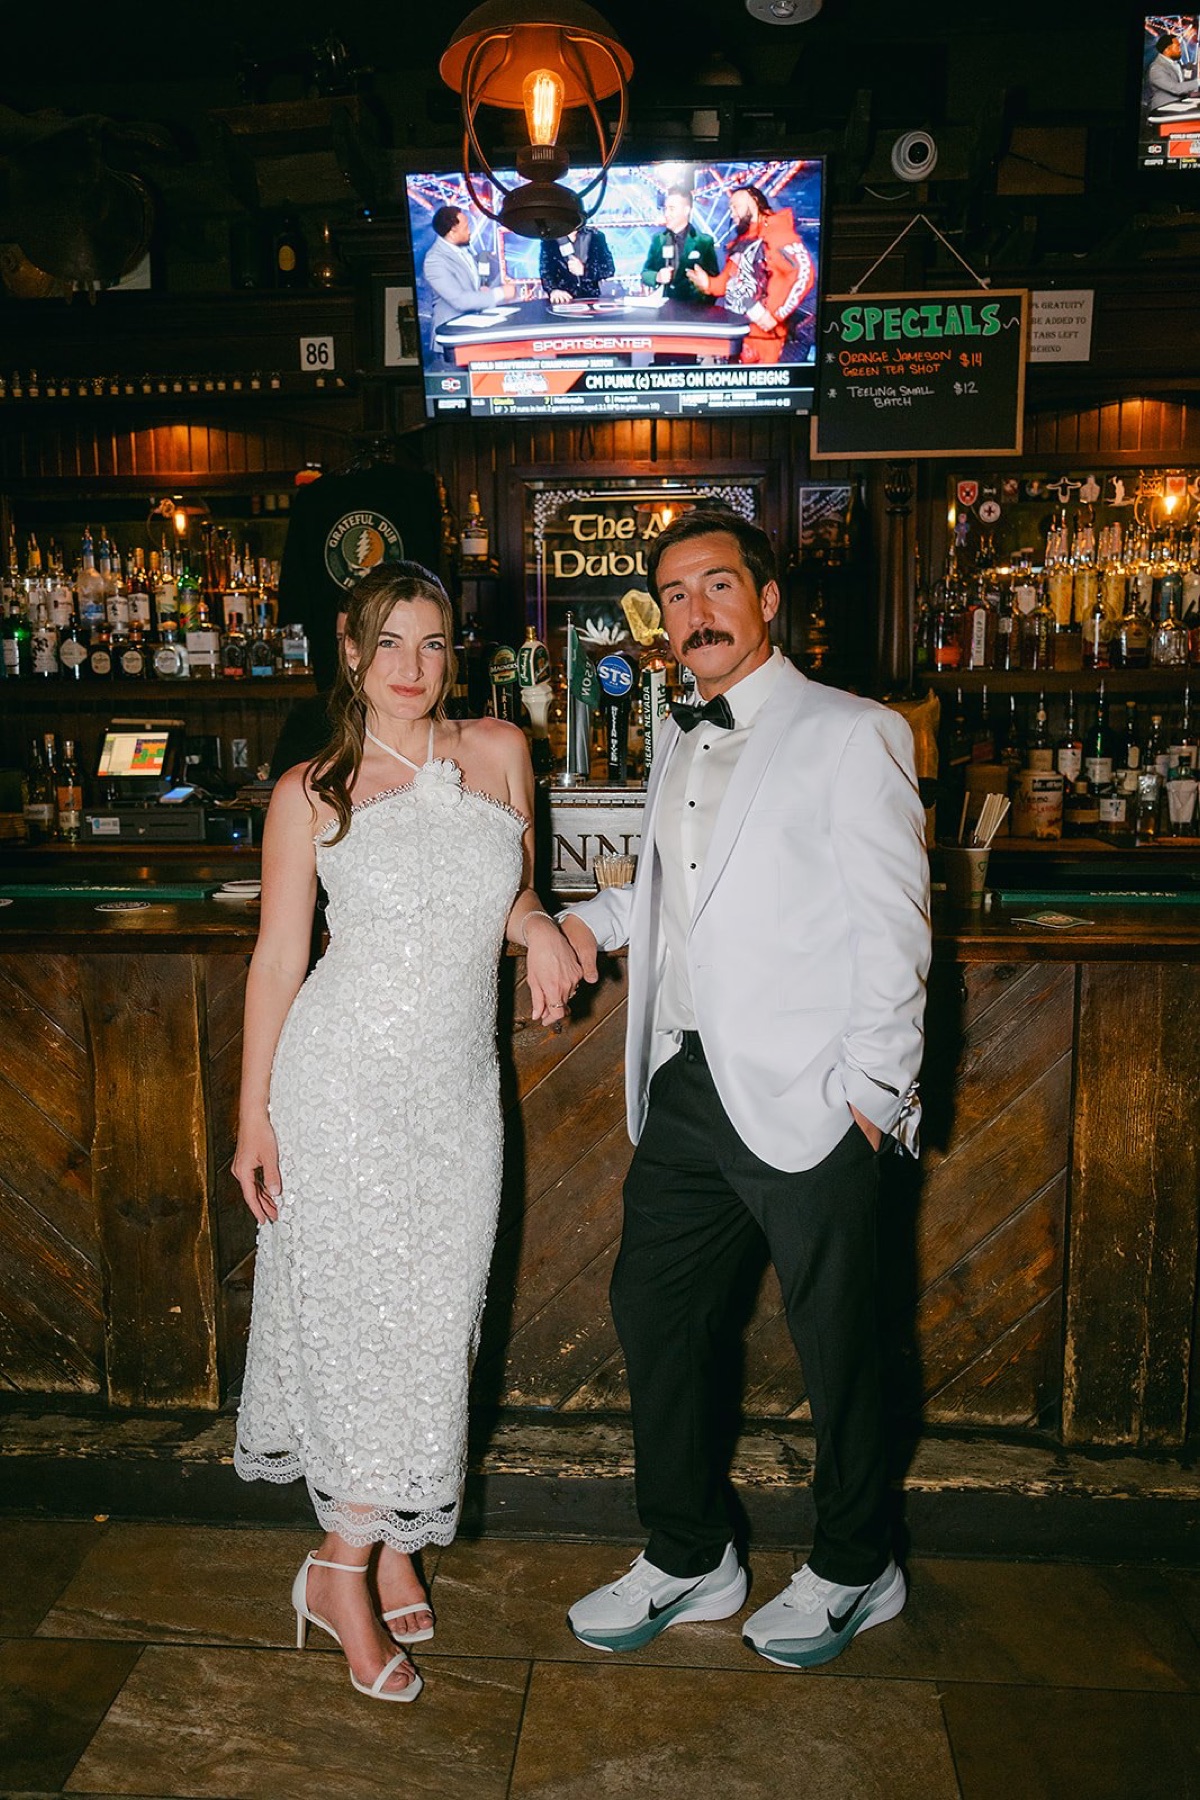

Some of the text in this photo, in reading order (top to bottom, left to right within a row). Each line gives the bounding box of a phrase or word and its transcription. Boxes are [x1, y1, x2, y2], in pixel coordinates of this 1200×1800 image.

[1041, 300, 1085, 309] GRATUITY
[840, 303, 1001, 342] SPECIALS
[1045, 317, 1074, 325] ADDED
[1075, 316, 1087, 325] TO
[1058, 331, 1079, 339] LEFT
[532, 336, 652, 352] SPORTSCENTER
[1031, 345, 1062, 353] BEHIND
[306, 342, 329, 365] 86
[959, 352, 983, 368] $14
[842, 363, 941, 377] GREEN TEA SHOT
[441, 379, 462, 391] SC
[585, 374, 603, 389] CM
[604, 374, 635, 389] PUNK
[650, 372, 685, 388] TAKES
[686, 372, 704, 387] ON
[705, 371, 748, 386] ROMAN
[749, 370, 790, 386] REIGNS
[898, 385, 935, 397] SMALL
[953, 381, 979, 396] $12
[873, 397, 912, 408] BATCH
[328, 513, 375, 548] GRATEFUL
[567, 513, 637, 541] The
[552, 549, 649, 578] Dubl
[598, 665, 631, 686] STS
[642, 685, 652, 769] SIERRA NEVADA
